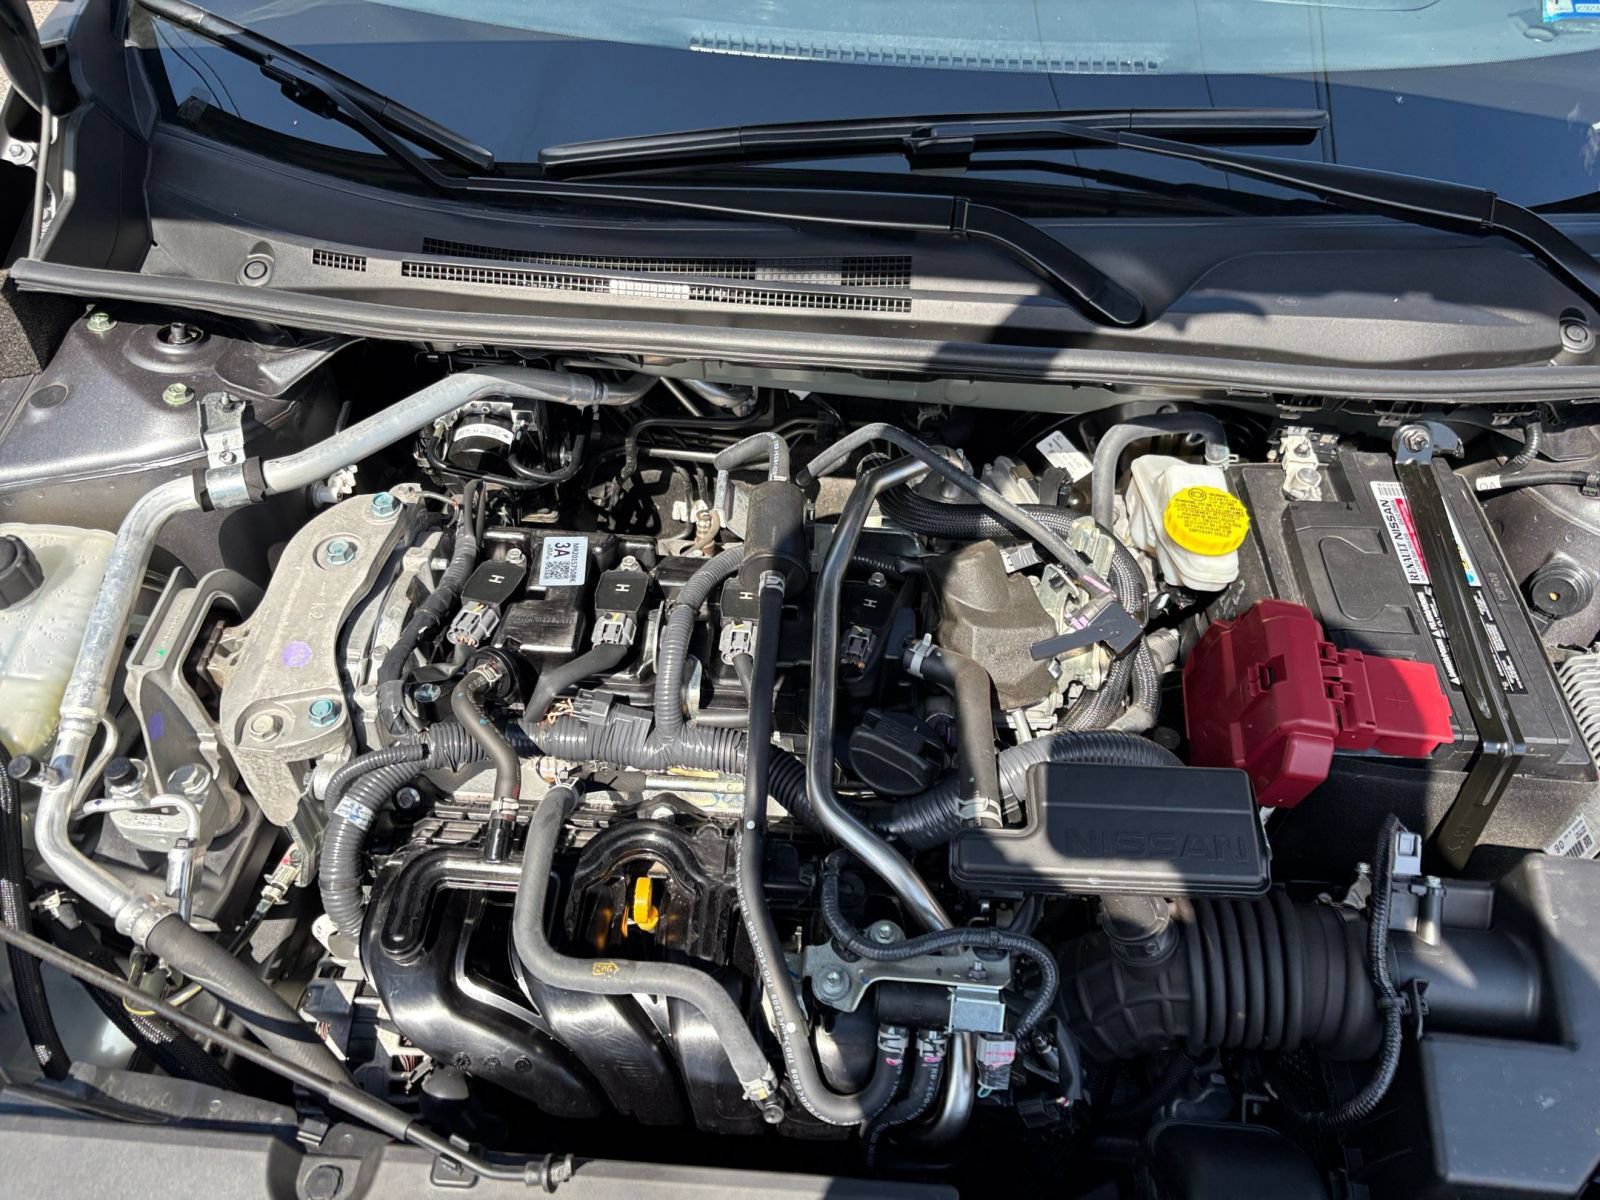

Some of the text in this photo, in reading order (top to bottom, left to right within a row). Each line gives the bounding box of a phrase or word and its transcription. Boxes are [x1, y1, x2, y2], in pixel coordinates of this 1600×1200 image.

[1379, 499, 1402, 541] NISSAN
[554, 541, 571, 559] 3A
[1399, 541, 1420, 582] RENAULT
[488, 574, 505, 584] H
[615, 583, 631, 592] H
[739, 591, 754, 600] H
[863, 598, 878, 609] H
[1063, 828, 1248, 862] NISSAN
